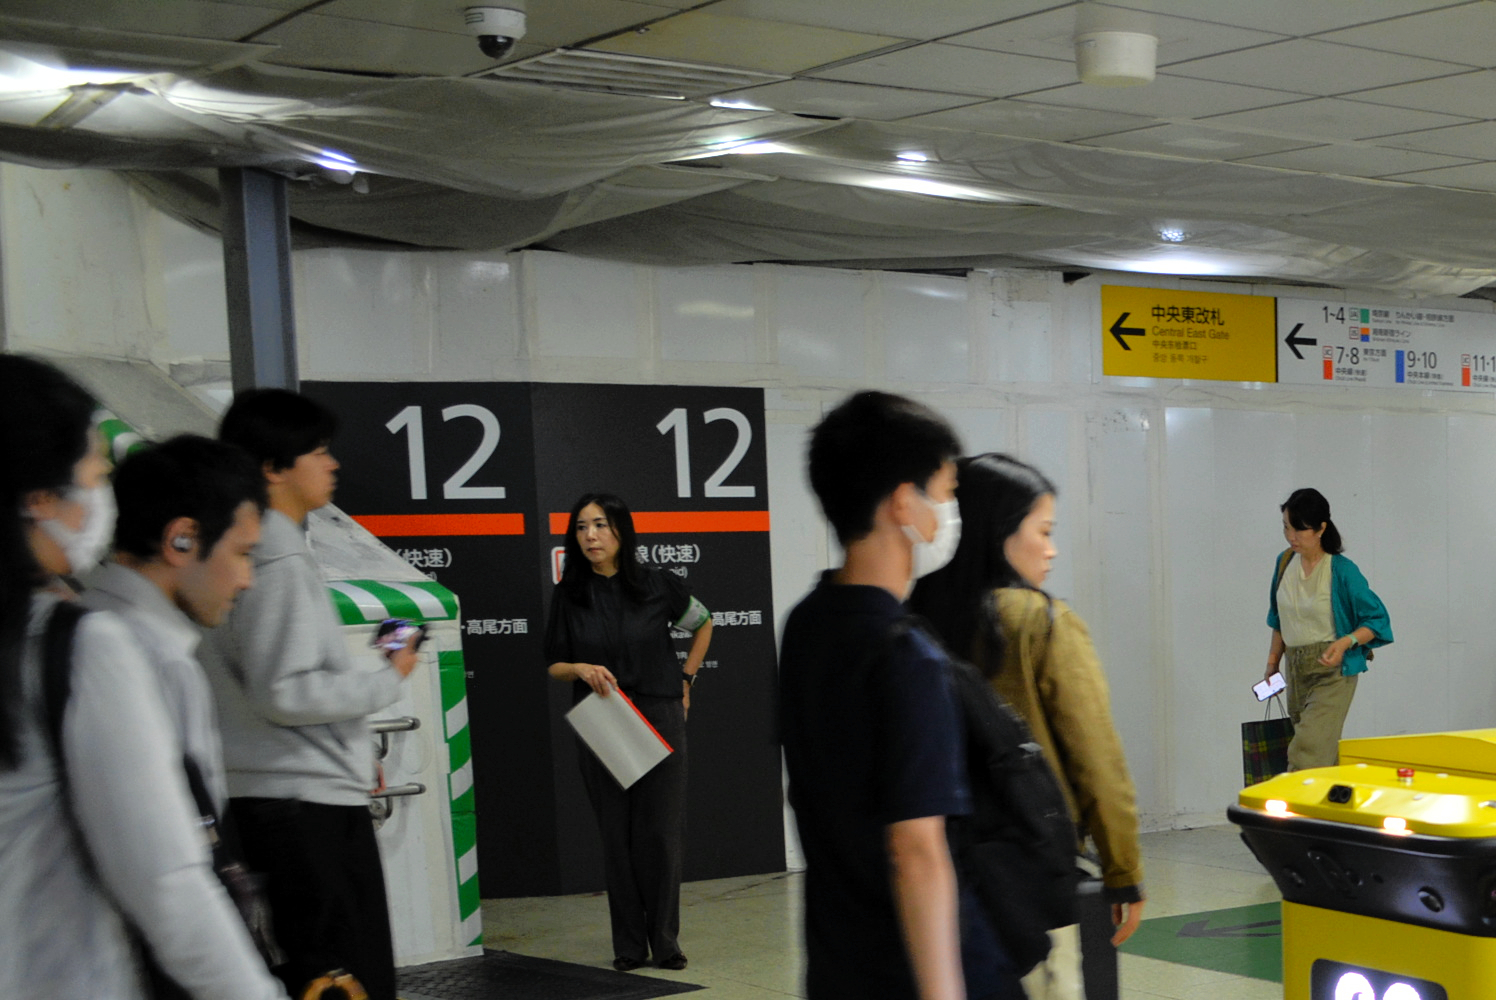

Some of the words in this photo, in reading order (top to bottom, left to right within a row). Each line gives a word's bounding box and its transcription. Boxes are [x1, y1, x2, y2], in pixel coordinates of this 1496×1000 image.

[1152, 304, 1225, 326] 中央東改札
[1152, 326, 1185, 338] Central
[1187, 328, 1207, 339] East
[1208, 329, 1231, 341] Gate
[385, 404, 506, 499] 12
[656, 407, 757, 498] 12
[711, 610, 763, 627] 高尾方面
